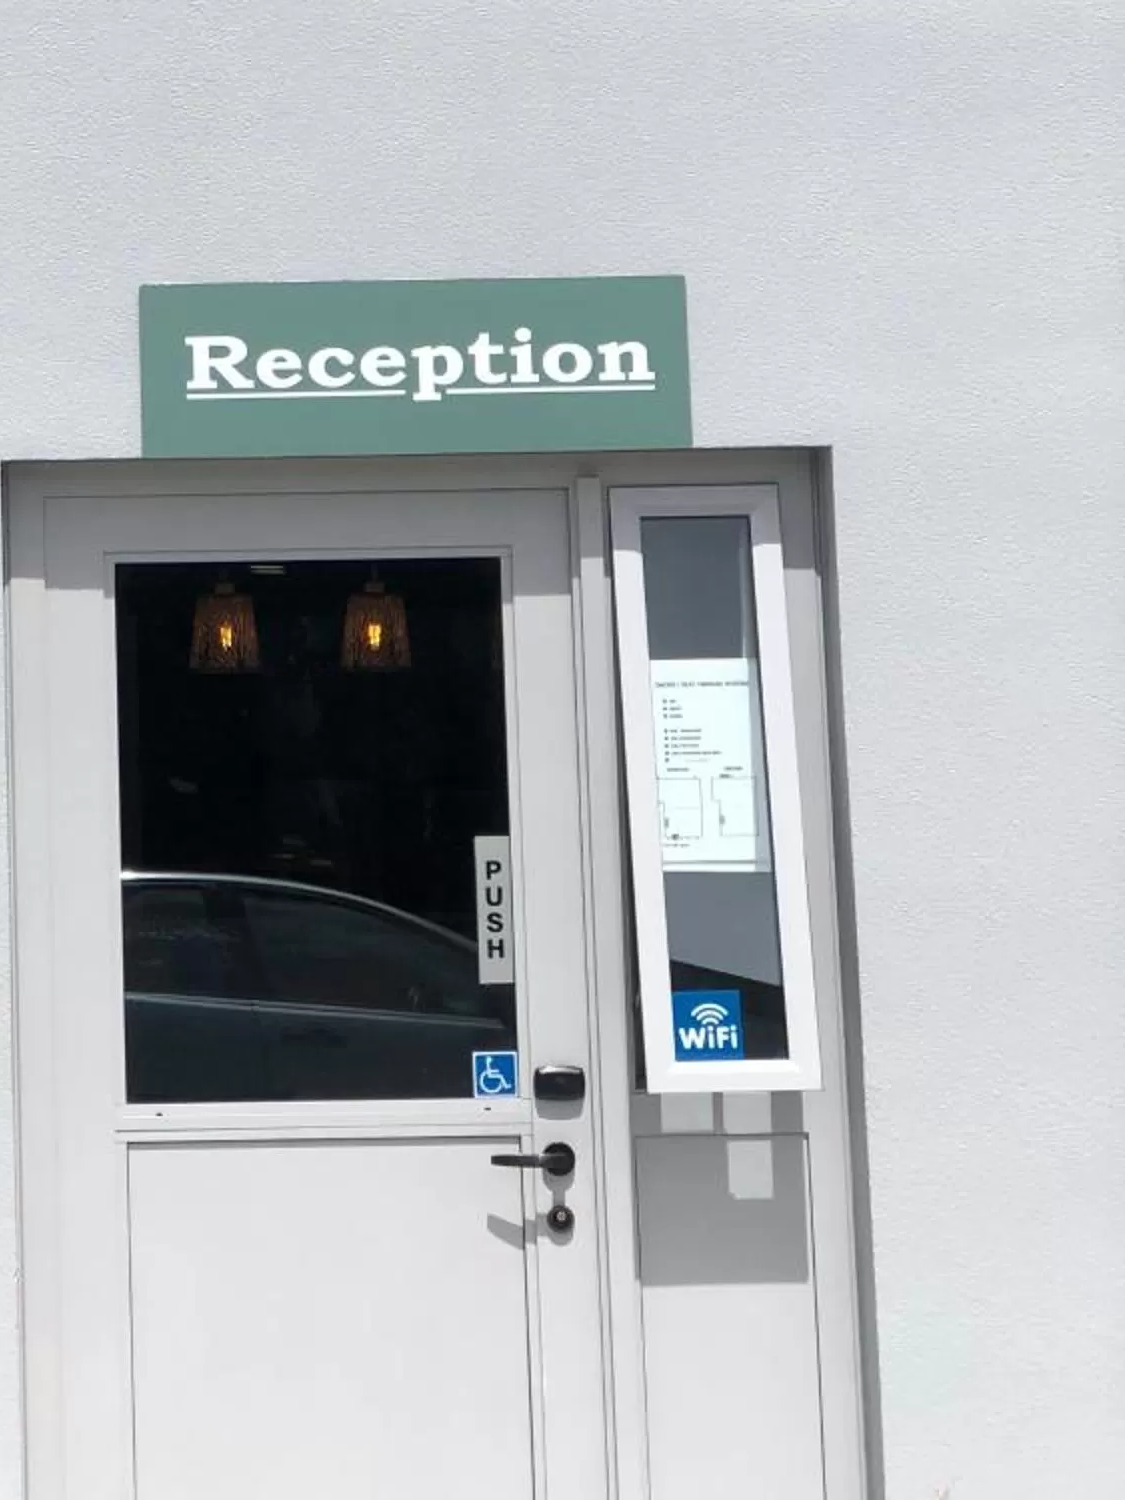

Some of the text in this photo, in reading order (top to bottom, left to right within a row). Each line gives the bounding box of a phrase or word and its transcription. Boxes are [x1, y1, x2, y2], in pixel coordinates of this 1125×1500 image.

[185, 327, 656, 401] Reception
[484, 860, 505, 959] PUSH
[678, 1025, 739, 1050] WiFi
